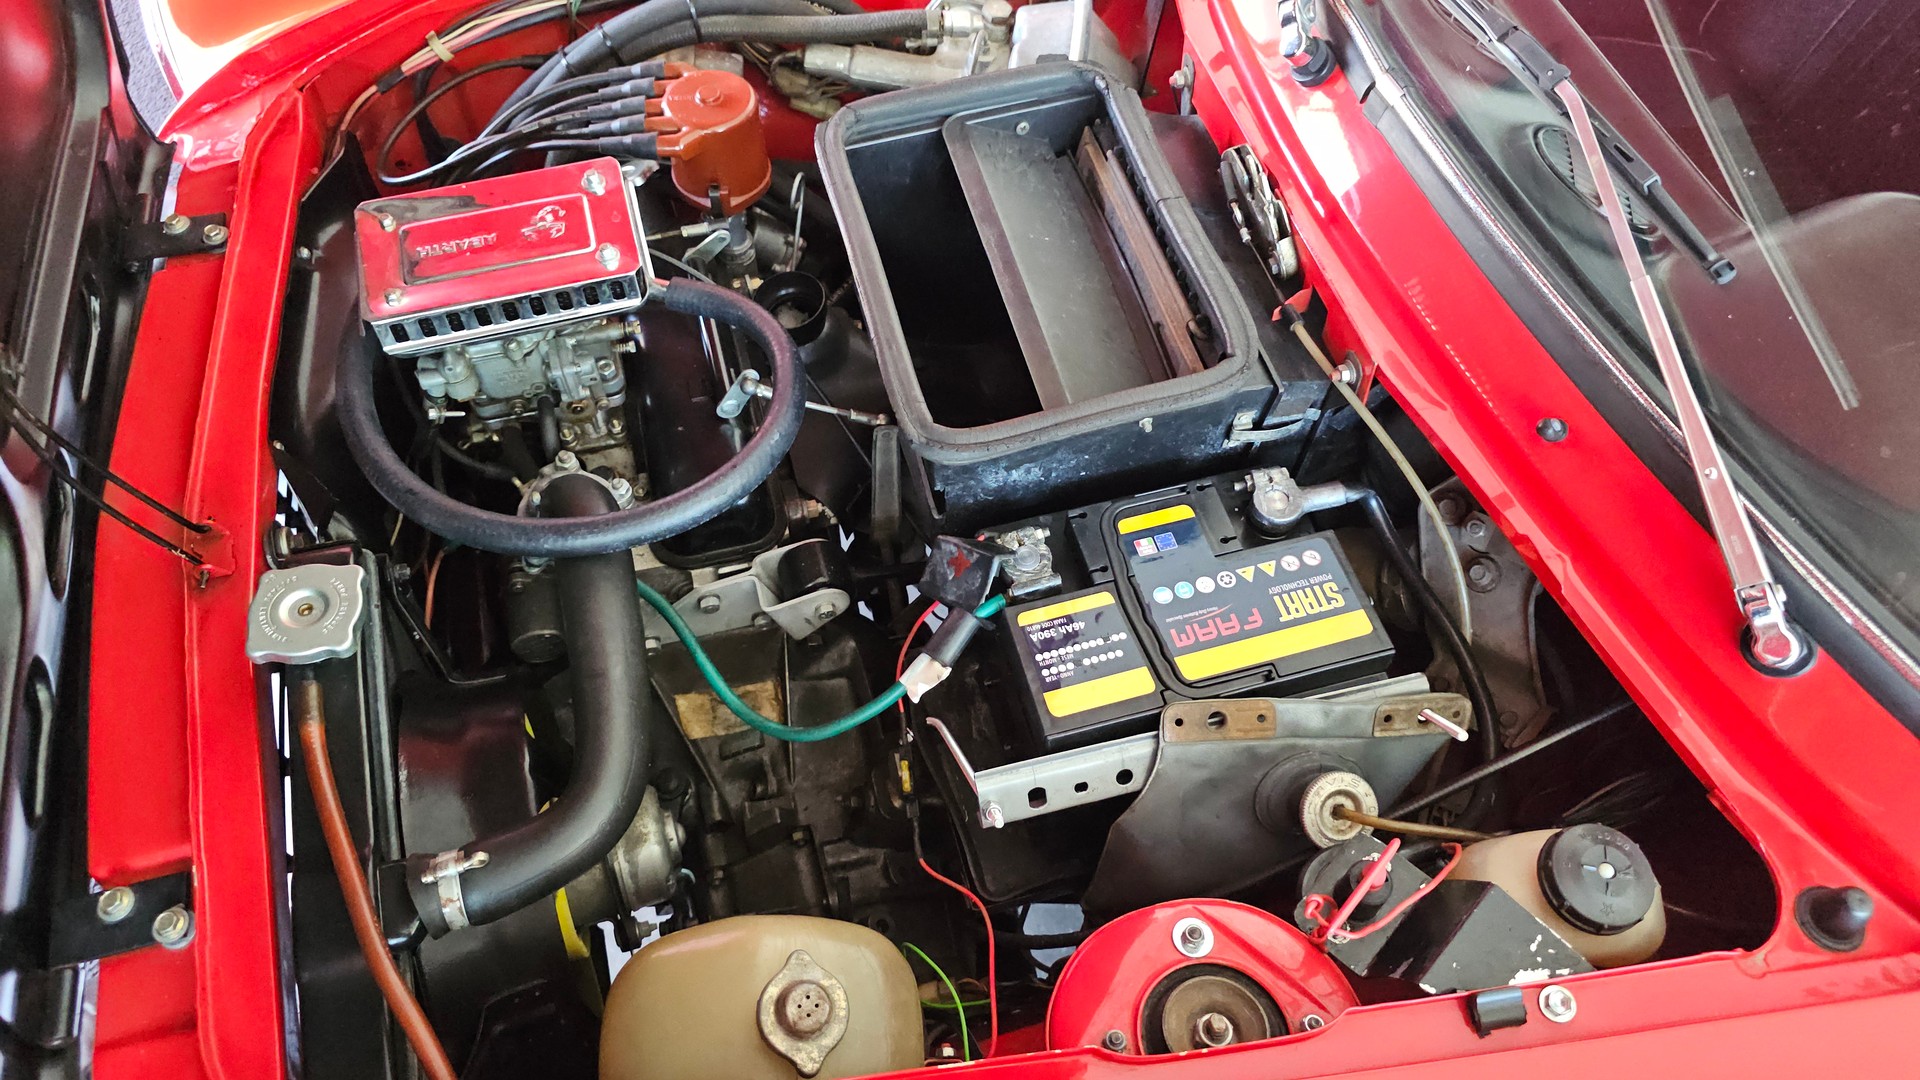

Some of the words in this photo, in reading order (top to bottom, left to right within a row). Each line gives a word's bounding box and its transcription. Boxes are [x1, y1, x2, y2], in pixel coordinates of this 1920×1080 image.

[416, 232, 497, 258] ABARTH
[1268, 577, 1309, 595] TECHNOLOGY
[1308, 573, 1332, 584] POWER
[1272, 581, 1345, 622] START
[1041, 620, 1054, 629] CODE
[1059, 621, 1085, 633] 46Ah
[1170, 607, 1263, 648] FAAM
[1029, 628, 1056, 641] 390A
